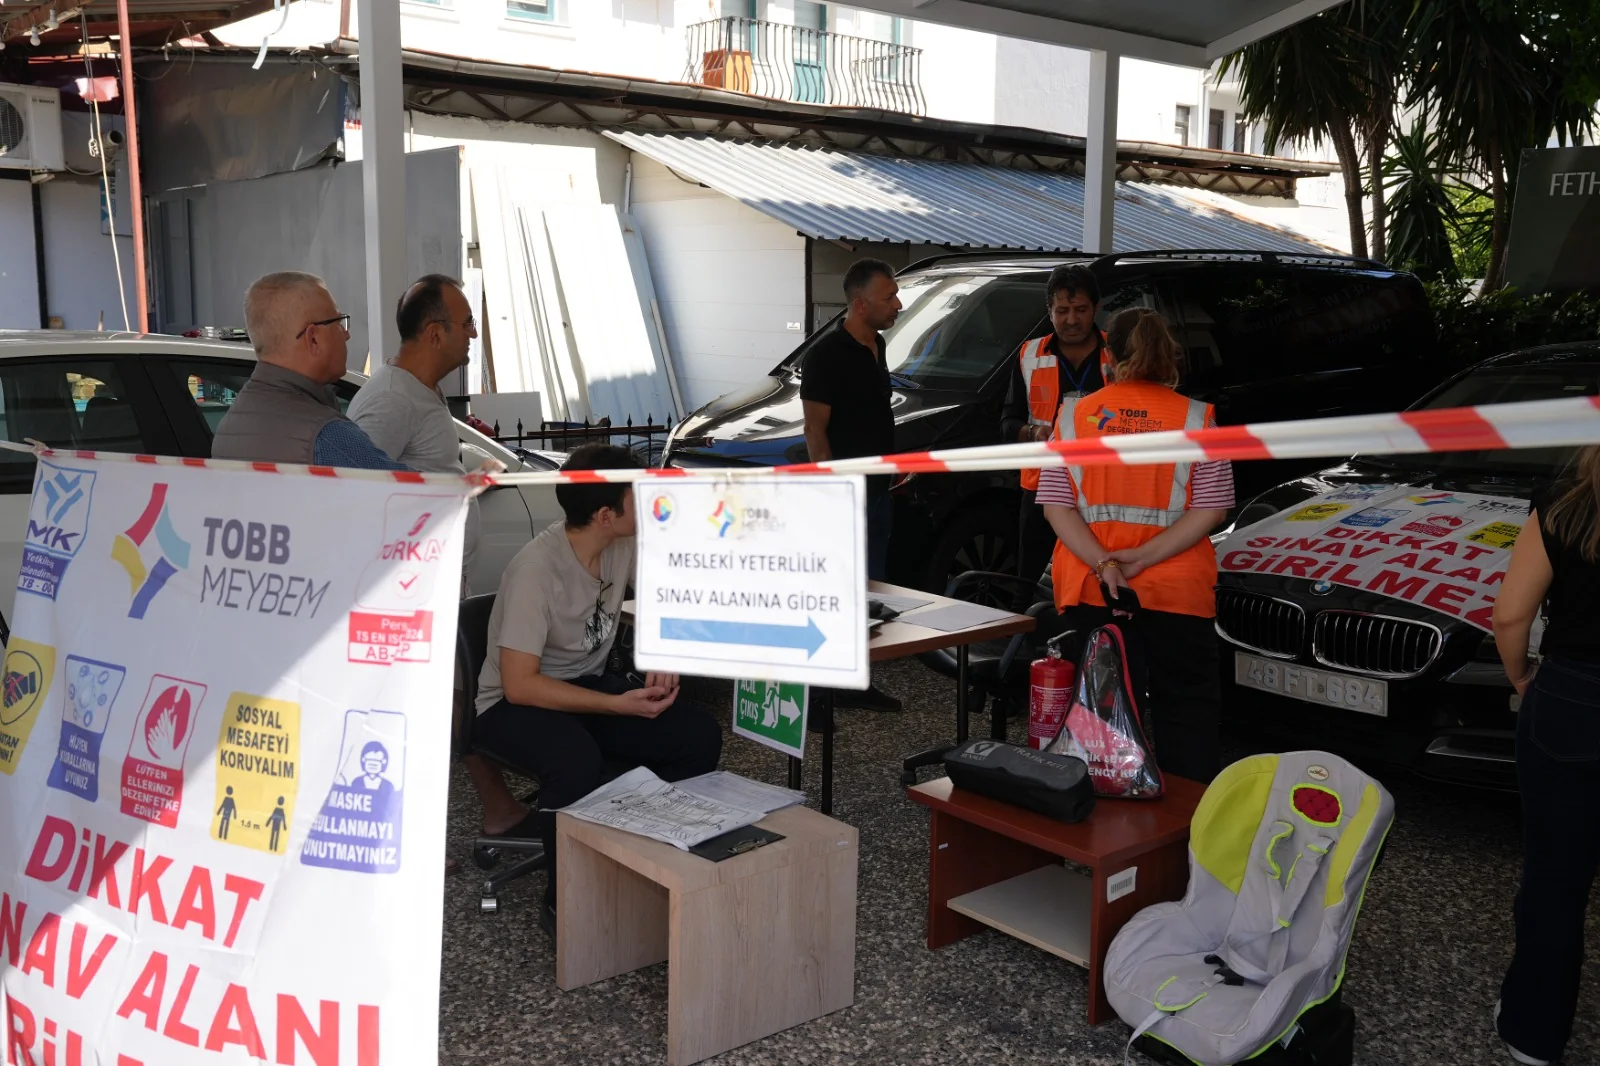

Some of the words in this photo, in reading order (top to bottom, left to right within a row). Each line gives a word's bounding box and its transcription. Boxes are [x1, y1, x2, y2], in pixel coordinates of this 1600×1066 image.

[1118, 408, 1148, 418] TOBB
[1120, 418, 1162, 428] MEYBEM
[204, 517, 291, 565] TOBB
[1246, 536, 1384, 559] SINAV
[668, 550, 734, 570] MESLEKİ
[739, 551, 828, 573] YETERLİLİK
[200, 564, 332, 619] MEYBEM
[656, 587, 704, 605] SINAV
[709, 589, 782, 609] ALANINA
[787, 590, 840, 613] GİDER
[371, 632, 386, 642] EN
[1246, 659, 1280, 690] 48
[1326, 676, 1382, 711] 684
[236, 703, 283, 730] SOSYAL
[226, 726, 289, 755] MESAFEYİ
[136, 763, 168, 780] LÜTFEN
[219, 749, 295, 779] KORUYALIM
[1088, 767, 1116, 778] ENCY
[327, 789, 373, 813] MASKE
[116, 950, 380, 1066] ALANI
